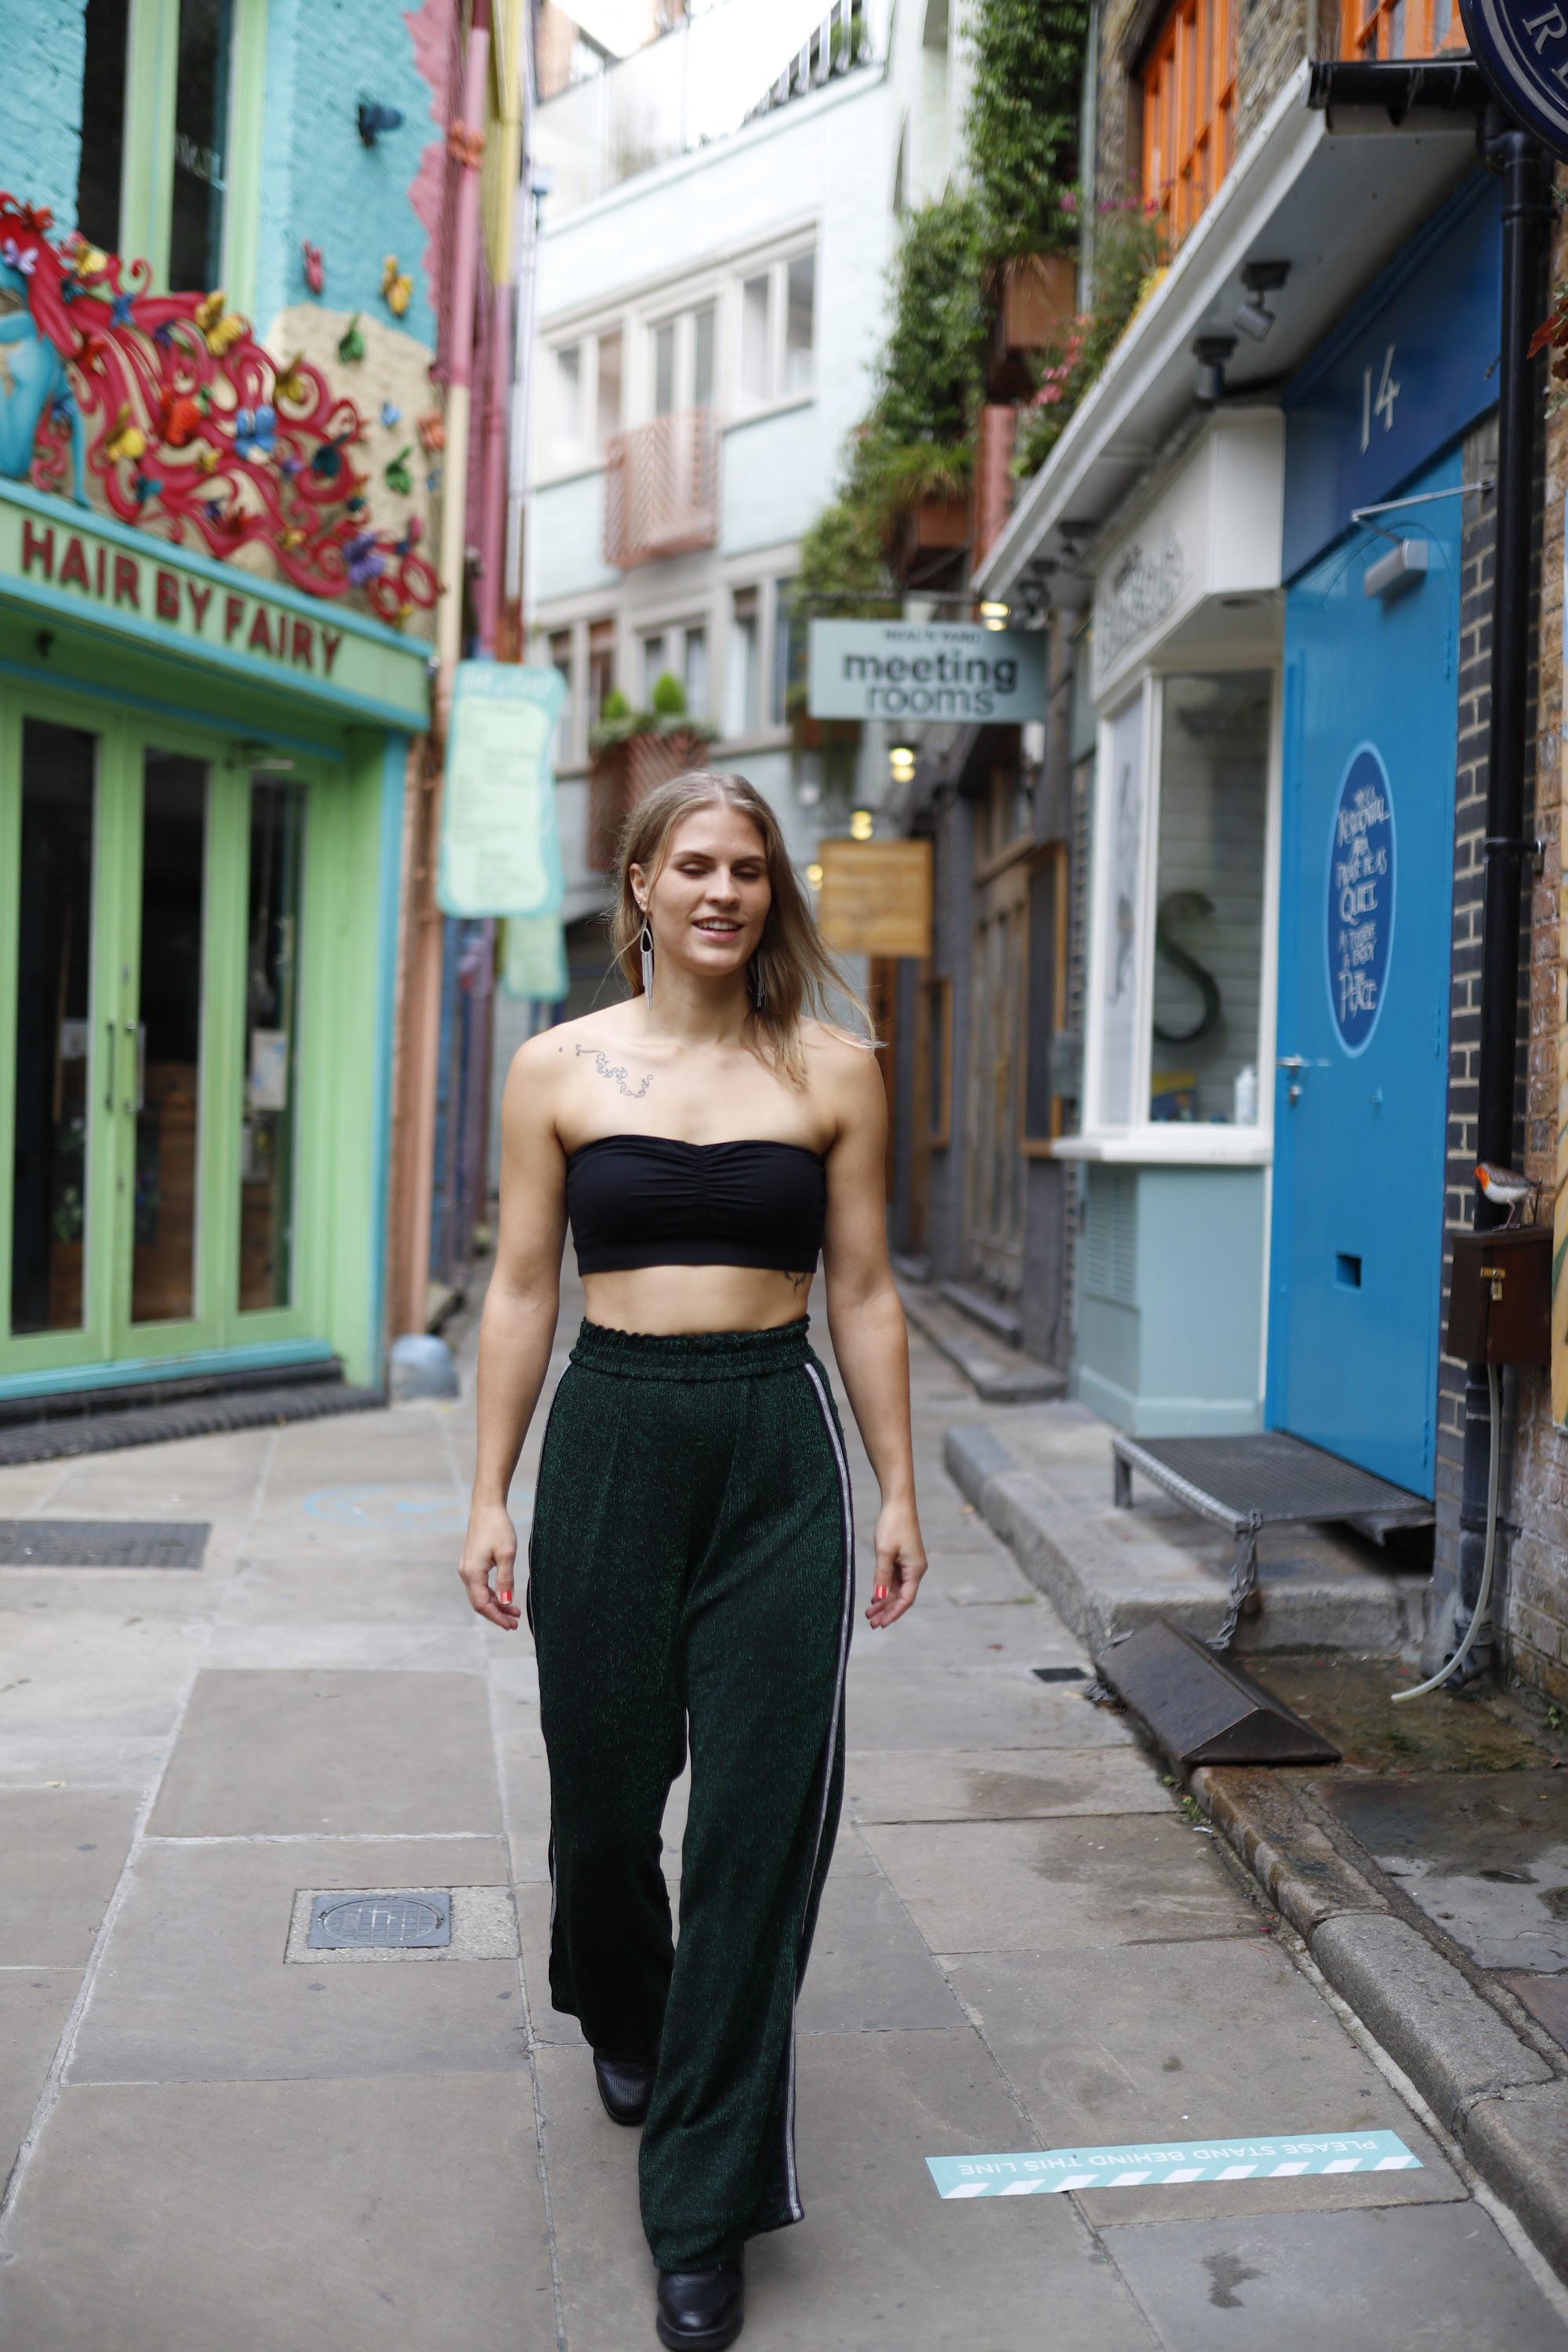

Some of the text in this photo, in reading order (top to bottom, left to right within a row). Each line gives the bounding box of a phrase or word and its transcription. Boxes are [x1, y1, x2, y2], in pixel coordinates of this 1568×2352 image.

[1359, 339, 1402, 456] 14
[21, 519, 343, 674] HAIR BY FAIRY
[843, 648, 1018, 694] meeting
[867, 687, 995, 715] rooms
[1339, 882, 1379, 926] QUIET
[1338, 968, 1377, 1023] PEACE
[957, 2139, 1378, 2176] PLEASE STAND BEHIND THIS LINE
